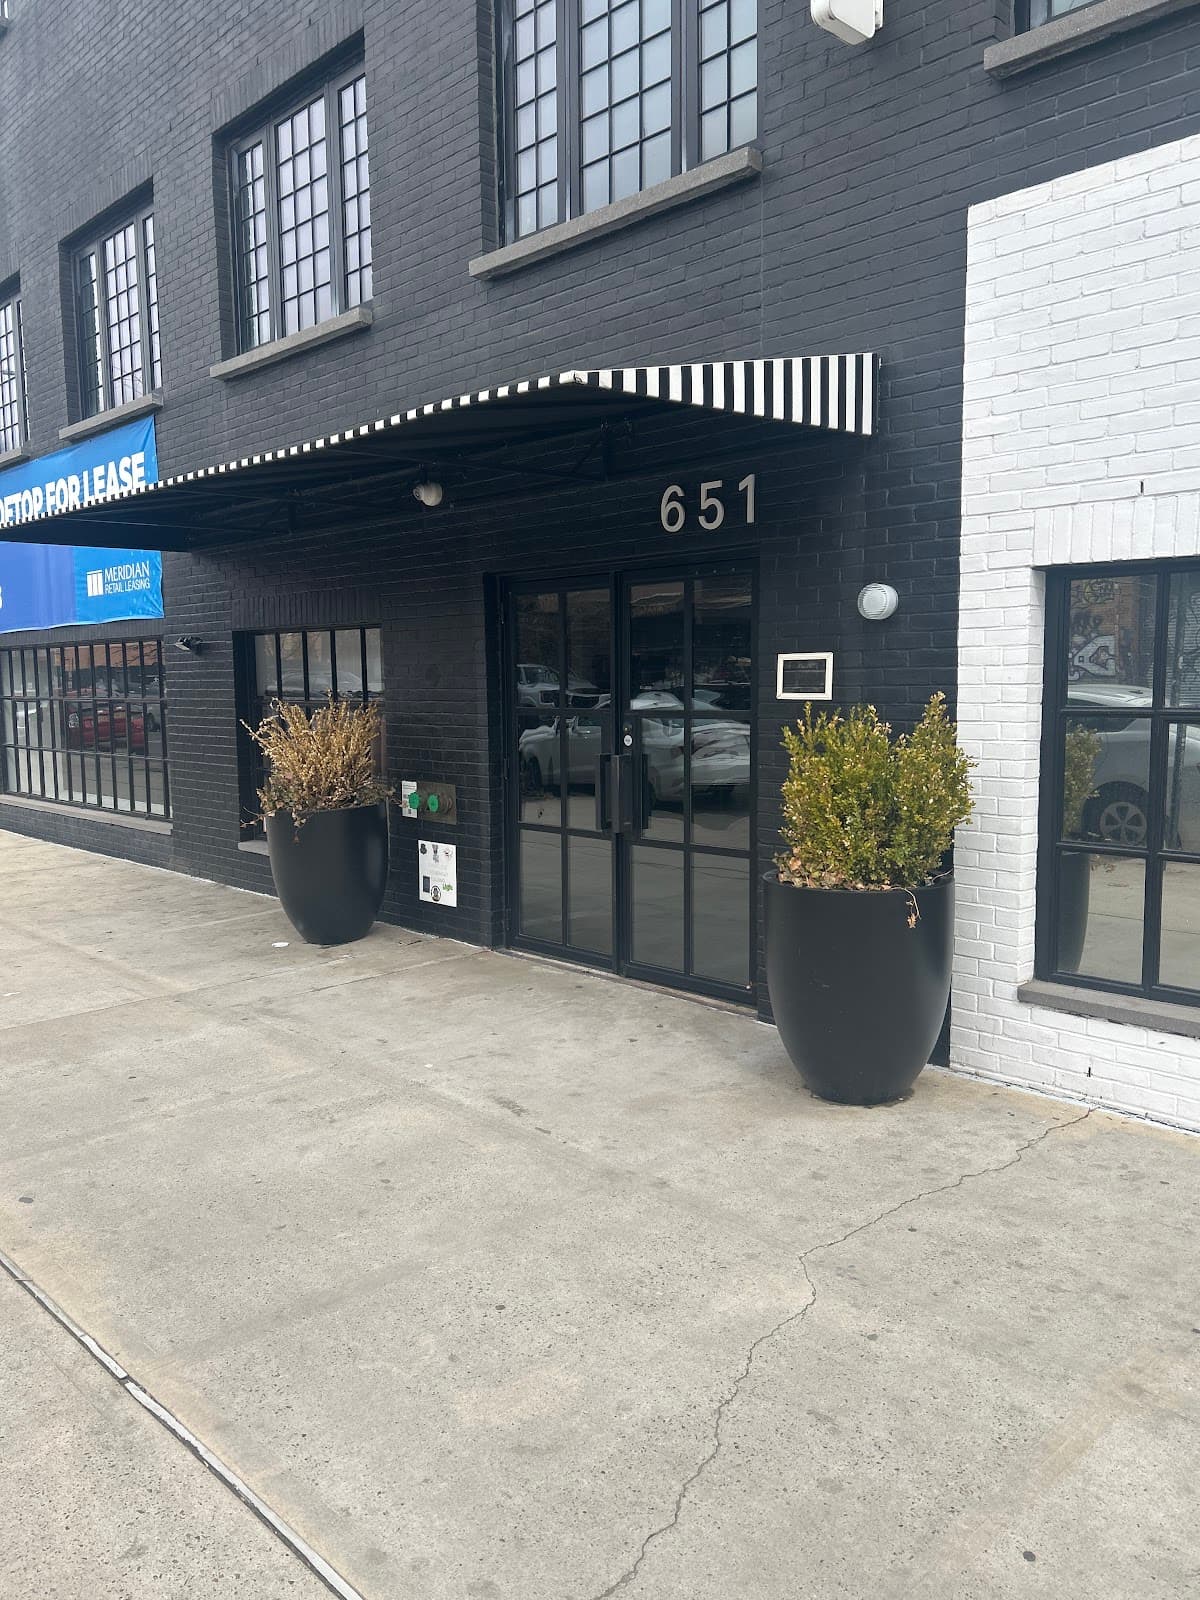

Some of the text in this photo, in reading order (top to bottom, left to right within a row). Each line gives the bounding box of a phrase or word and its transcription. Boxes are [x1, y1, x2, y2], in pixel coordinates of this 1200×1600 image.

[45, 474, 80, 511] FOR
[83, 452, 145, 502] LEASE
[661, 474, 755, 532] 651
[104, 560, 150, 583] MERIDIAN
[104, 577, 150, 594] RETAIL LEASING
